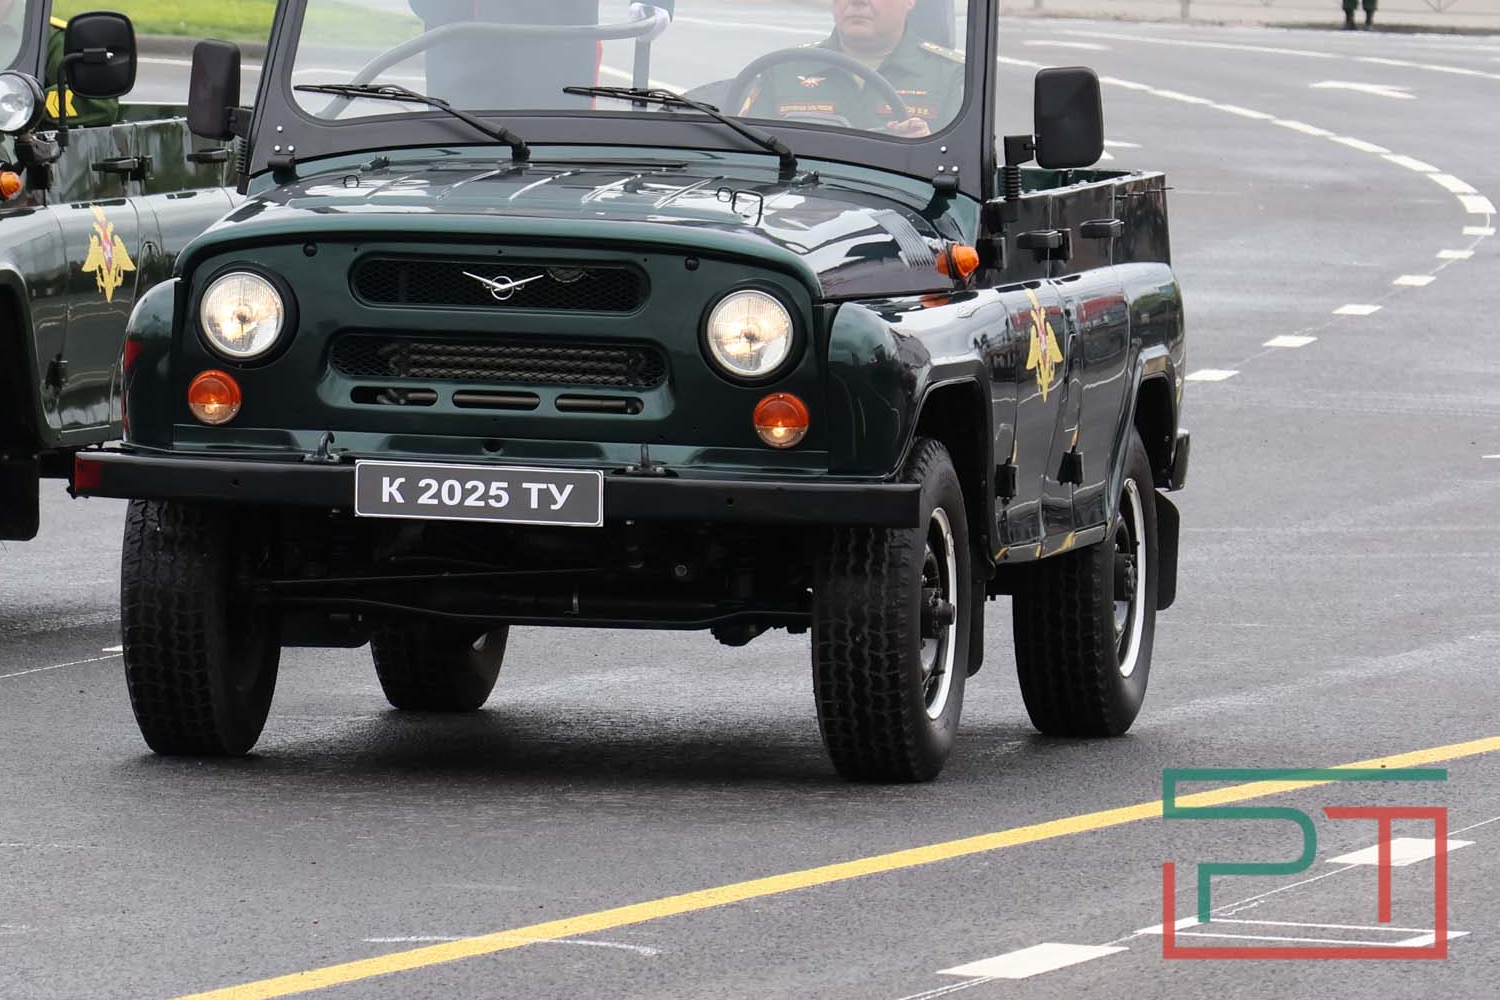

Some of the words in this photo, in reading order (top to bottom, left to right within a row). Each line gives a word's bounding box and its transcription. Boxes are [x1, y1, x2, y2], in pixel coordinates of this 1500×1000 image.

[381, 476, 406, 504] К
[417, 478, 510, 508] 2025
[522, 482, 575, 511] ТУ
